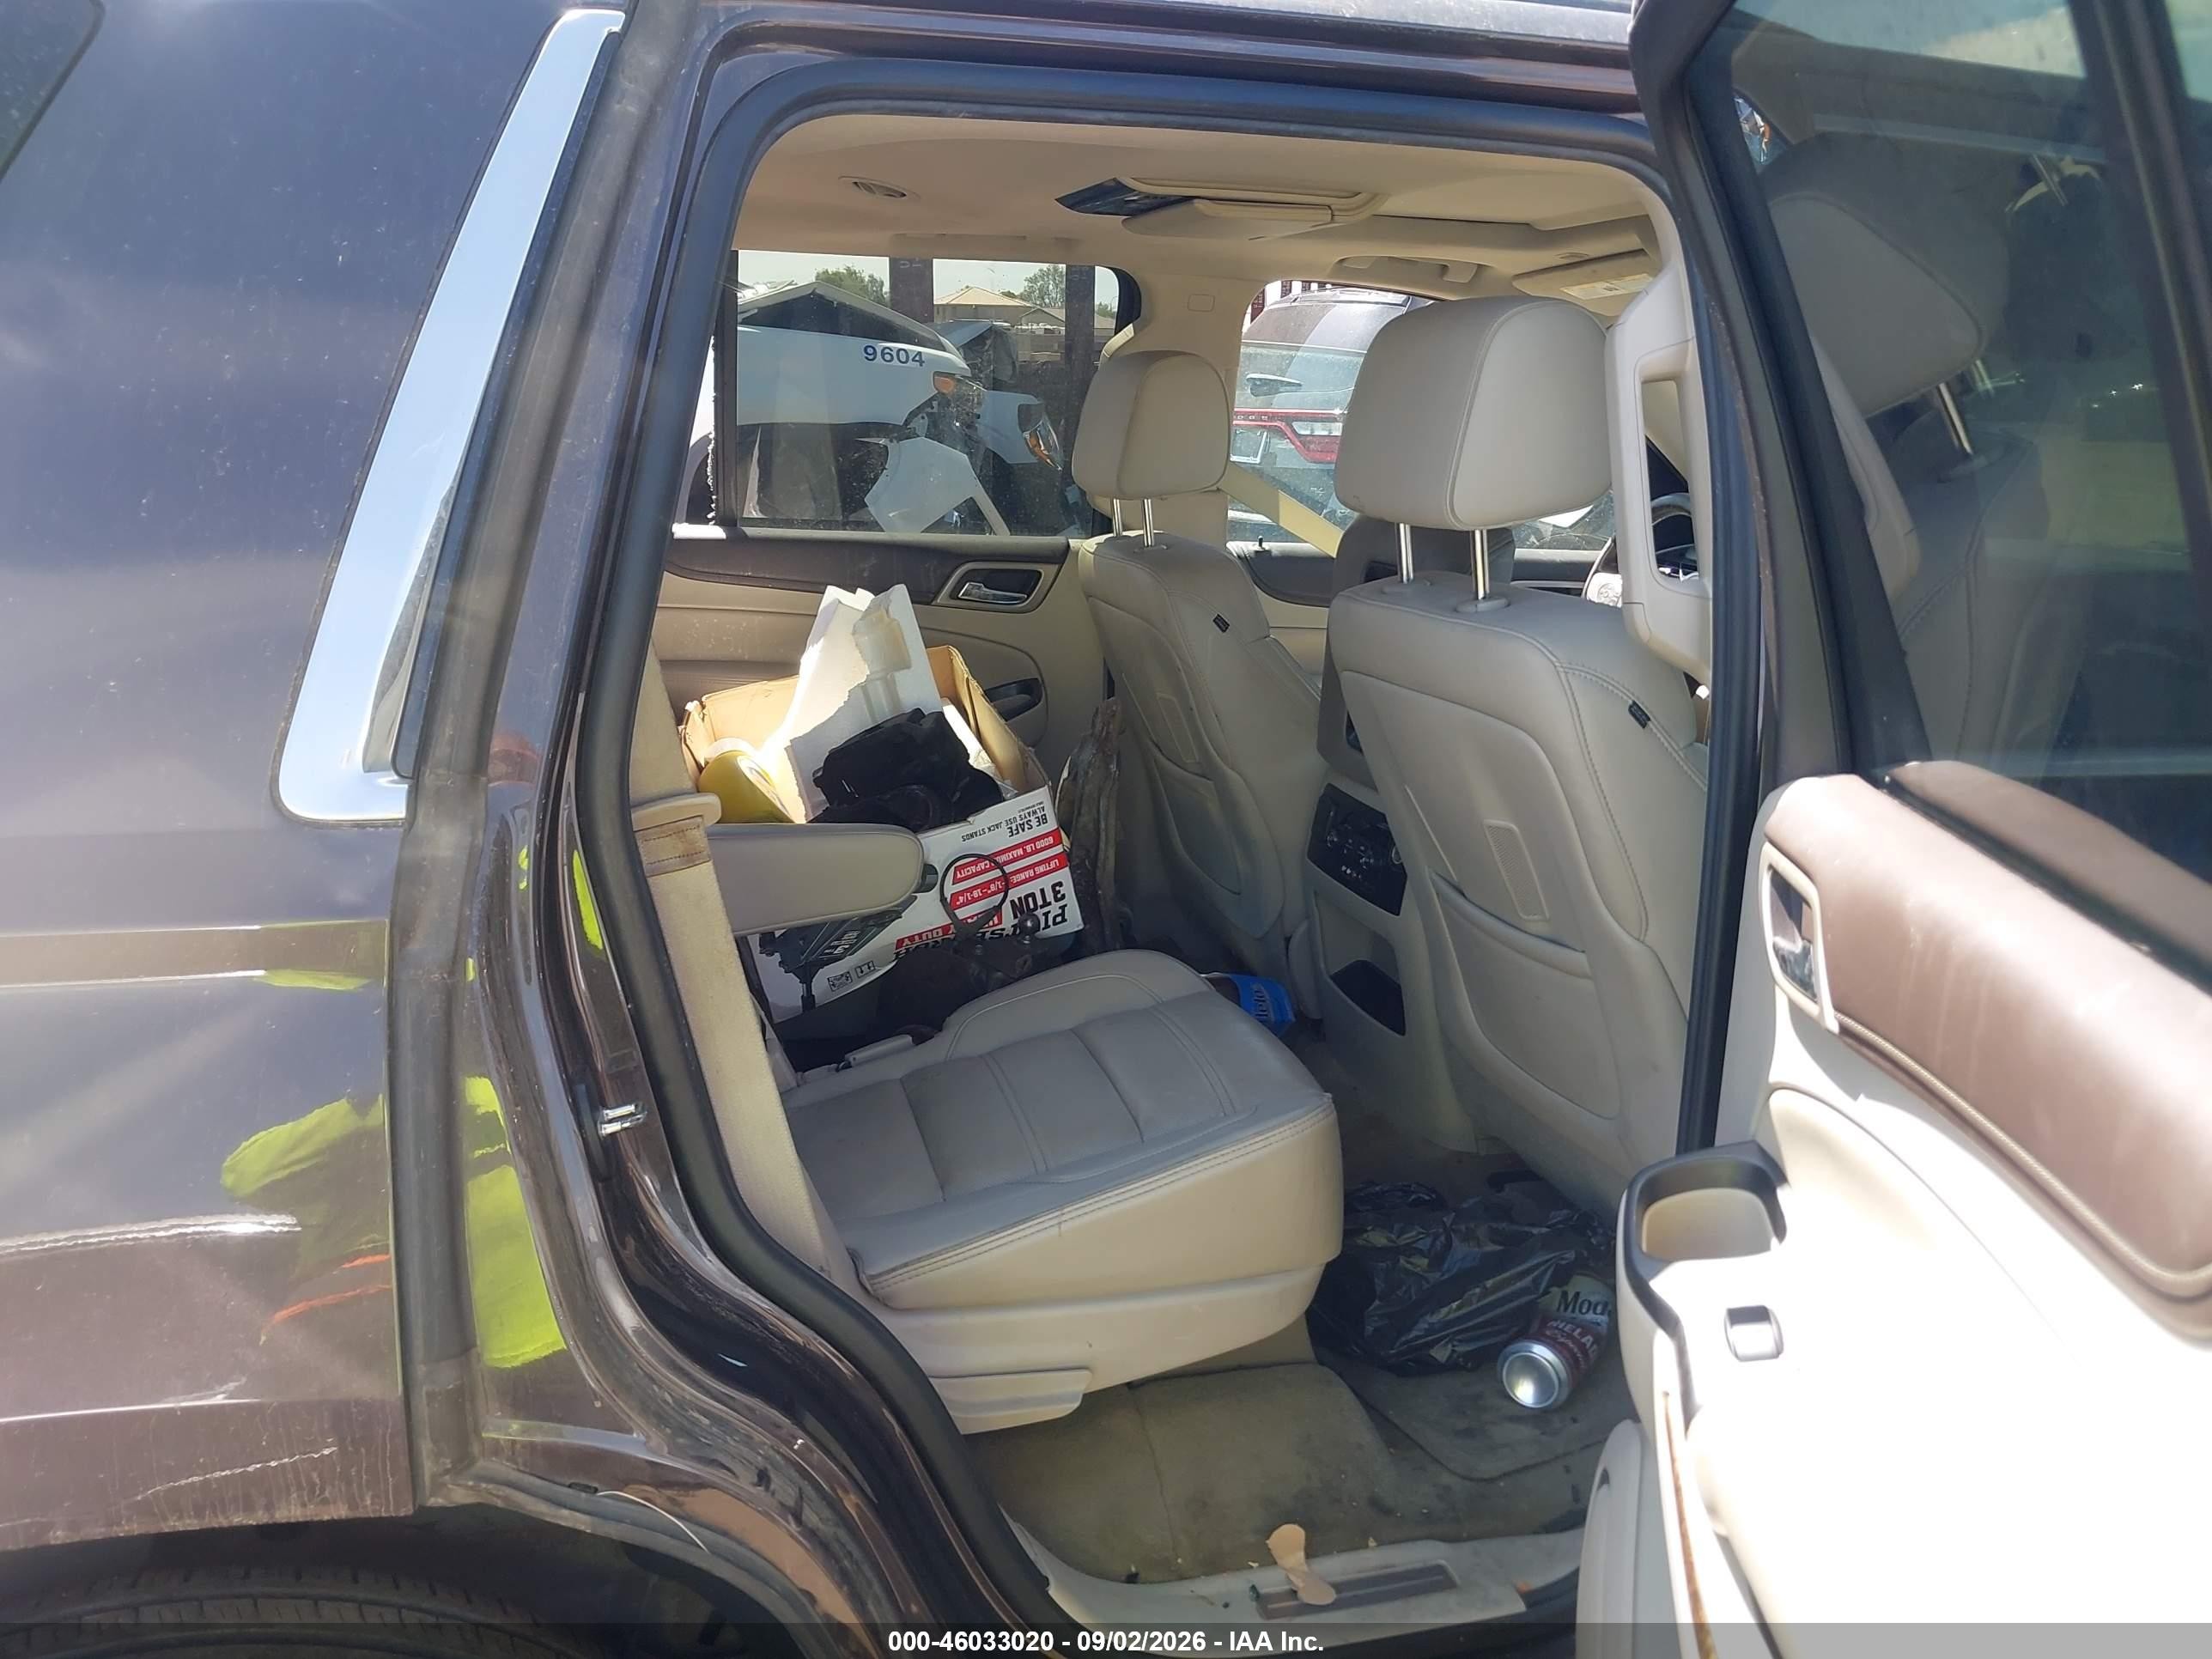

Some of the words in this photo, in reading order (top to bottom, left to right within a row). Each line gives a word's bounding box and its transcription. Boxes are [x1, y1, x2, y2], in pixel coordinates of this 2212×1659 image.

[864, 345, 925, 367] 9604
[1005, 815, 1018, 827] USE
[1018, 805, 1045, 821] ALWAYS
[1036, 813, 1048, 828] BE
[961, 827, 987, 842] STANDS
[987, 821, 1003, 834] JACK
[1007, 818, 1033, 838] SAFE
[1036, 836, 1054, 849] 6000
[957, 859, 990, 879] CAPACITY
[1035, 859, 1060, 875] LIFTING
[902, 927, 943, 945] DUTY
